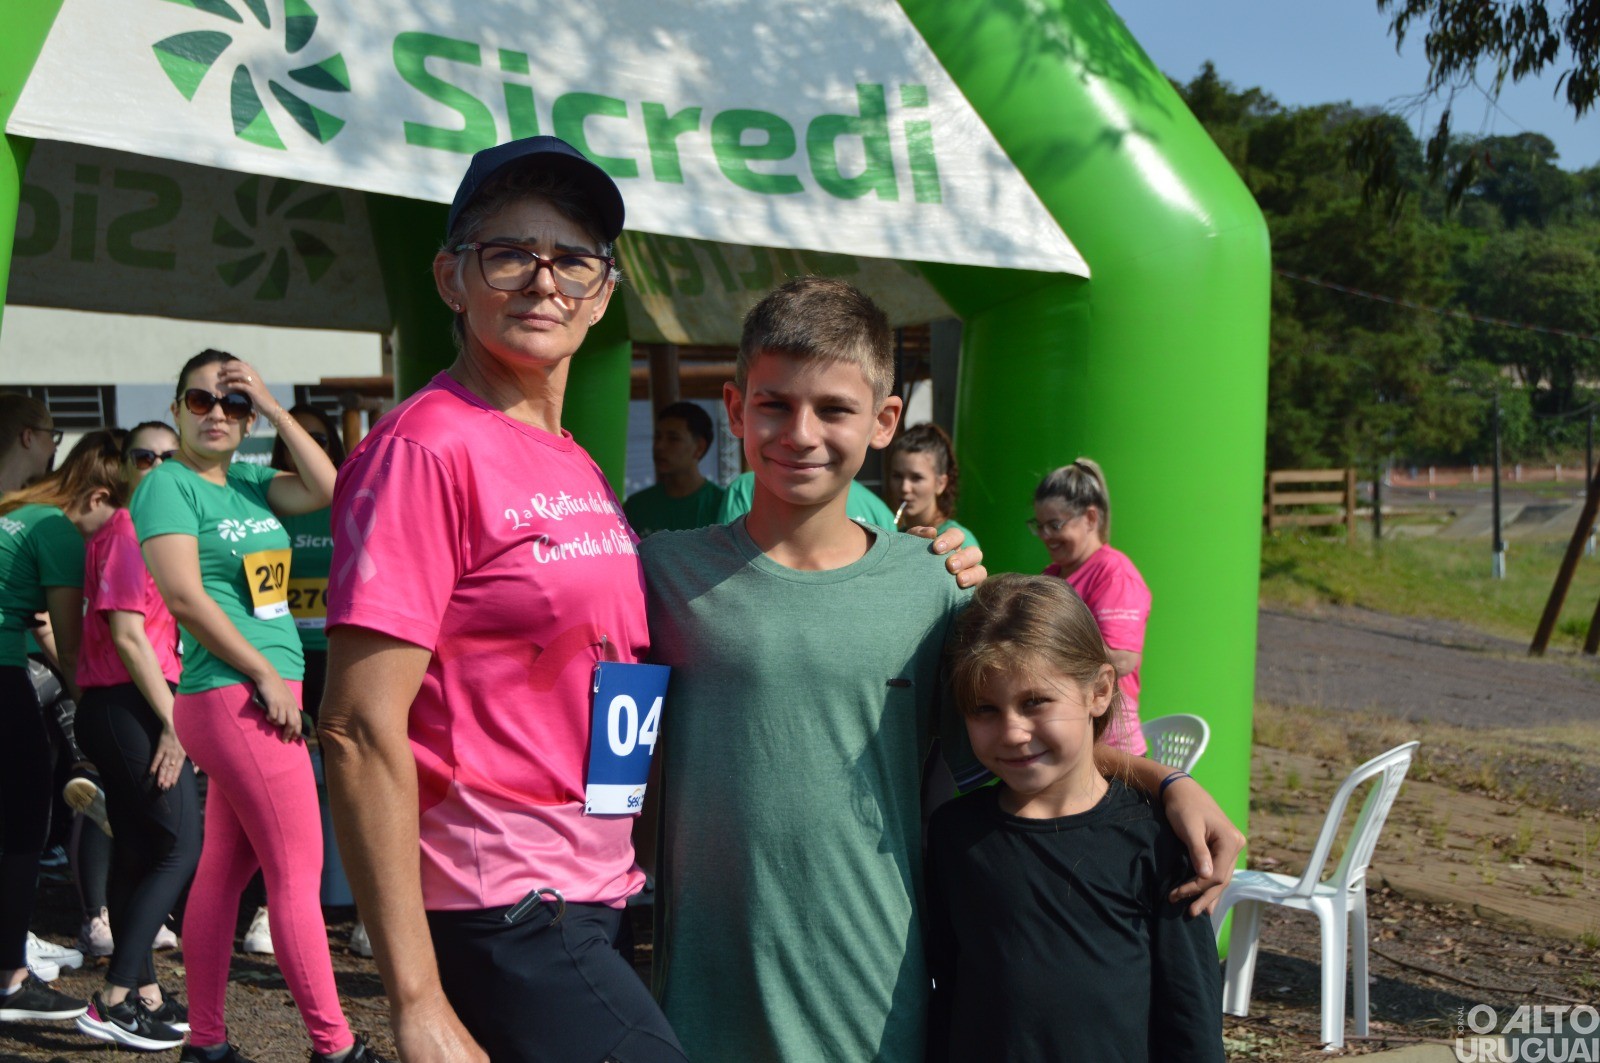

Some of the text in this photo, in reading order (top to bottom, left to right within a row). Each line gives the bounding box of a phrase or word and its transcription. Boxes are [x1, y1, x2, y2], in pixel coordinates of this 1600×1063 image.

[392, 31, 941, 203] Sicredi
[530, 490, 590, 521] Rústica
[244, 517, 282, 534] Sicre
[532, 532, 602, 563] Corrida
[607, 694, 663, 757] 04
